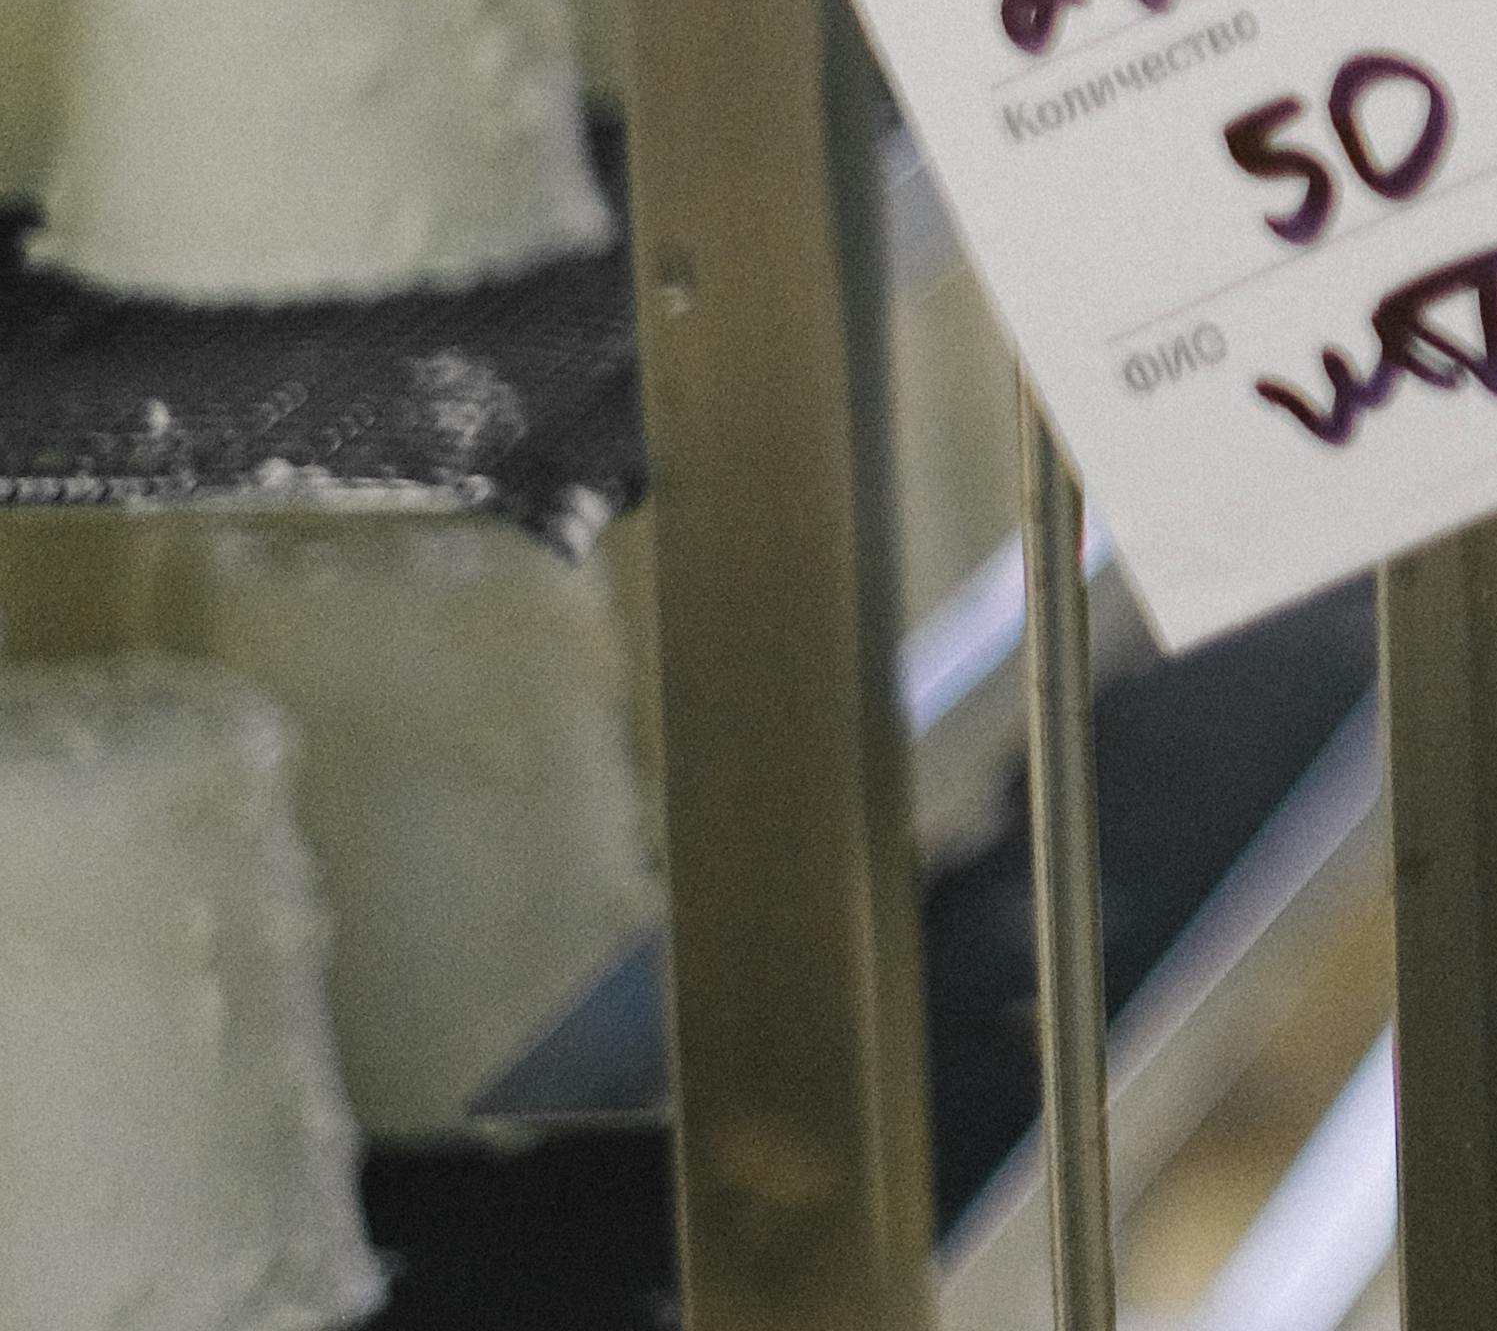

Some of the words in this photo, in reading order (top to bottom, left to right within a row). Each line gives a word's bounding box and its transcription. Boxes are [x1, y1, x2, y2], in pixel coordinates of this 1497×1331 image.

[1002, 9, 1262, 143] Количество
[1222, 52, 1452, 248] 50
[1122, 321, 1228, 394] ФИО
